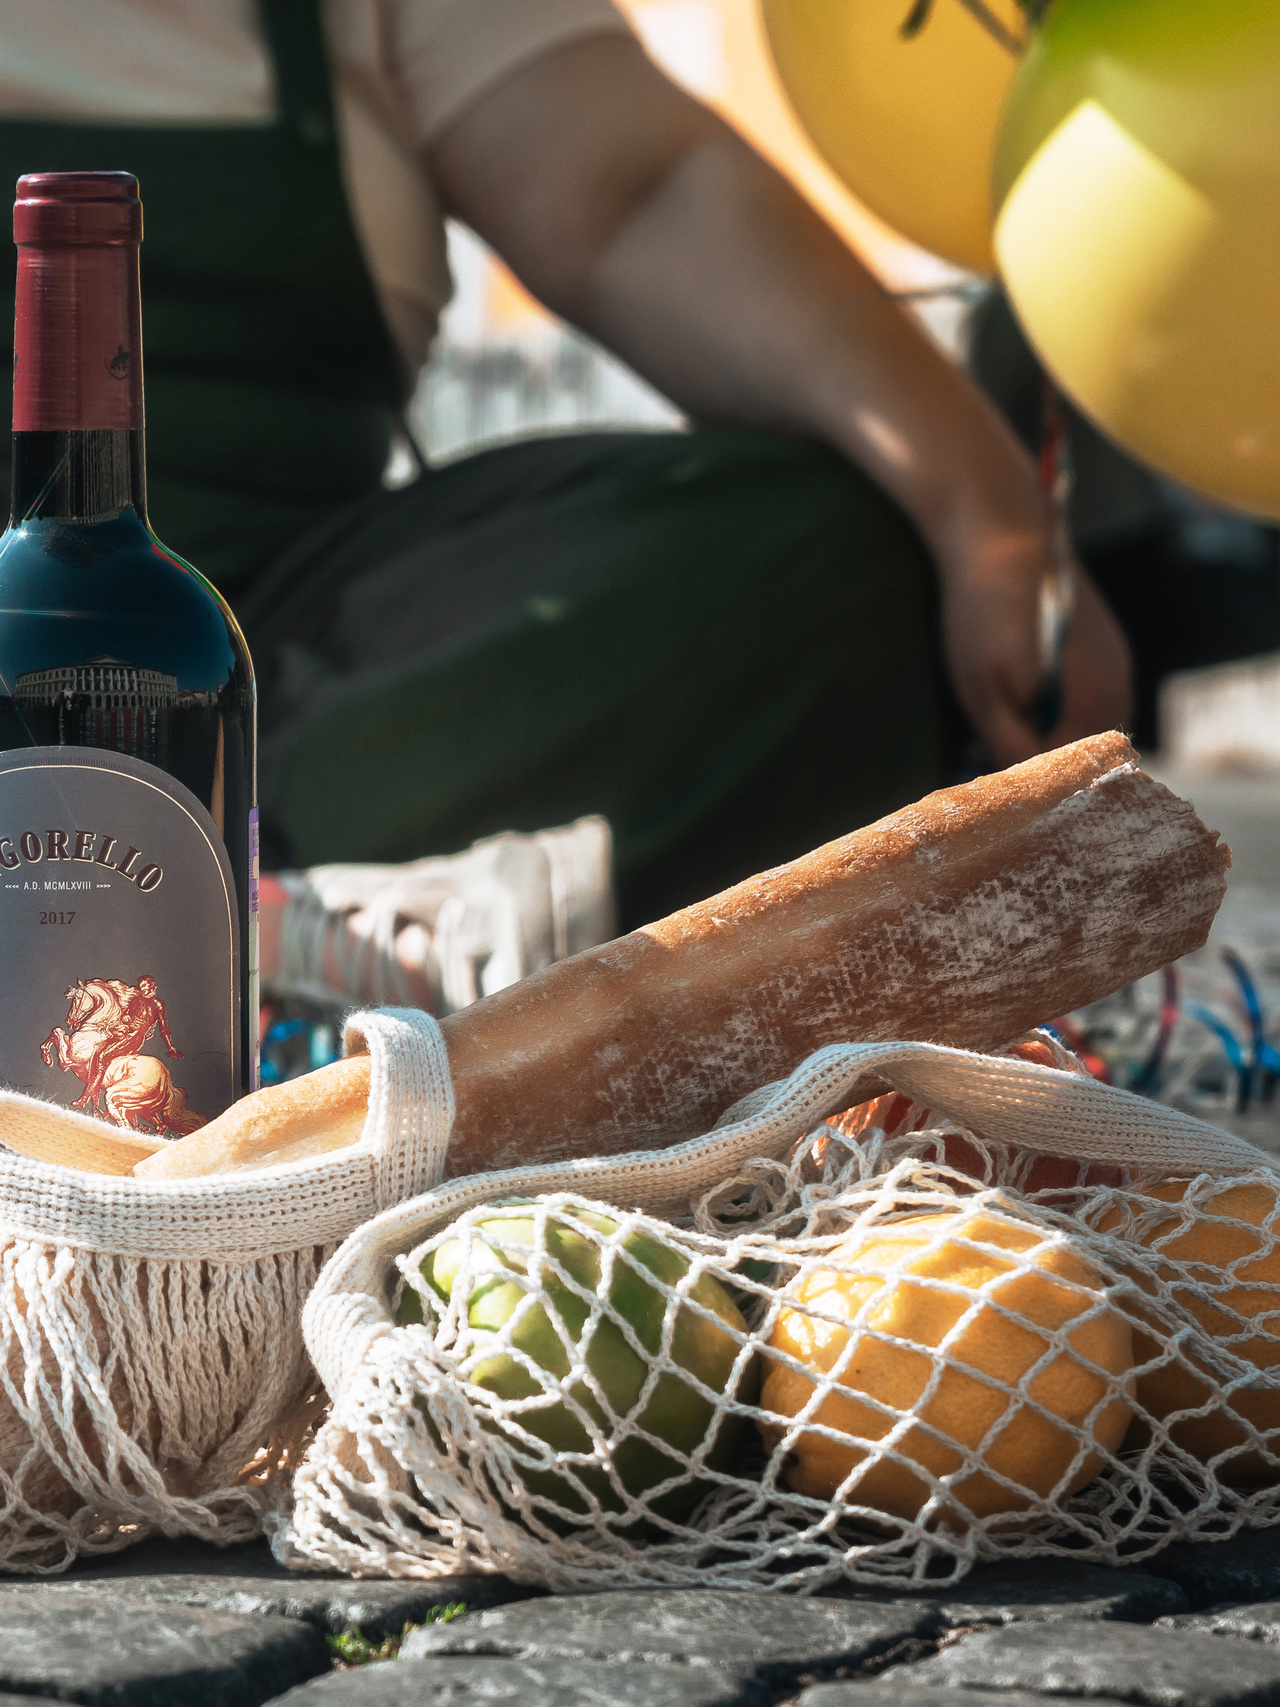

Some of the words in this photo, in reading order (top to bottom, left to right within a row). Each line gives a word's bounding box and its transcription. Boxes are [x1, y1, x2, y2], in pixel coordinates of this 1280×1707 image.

[23, 881, 41, 891] A.D.
[44, 881, 91, 891] MCMLXVIII
[39, 911, 76, 925] 2017
